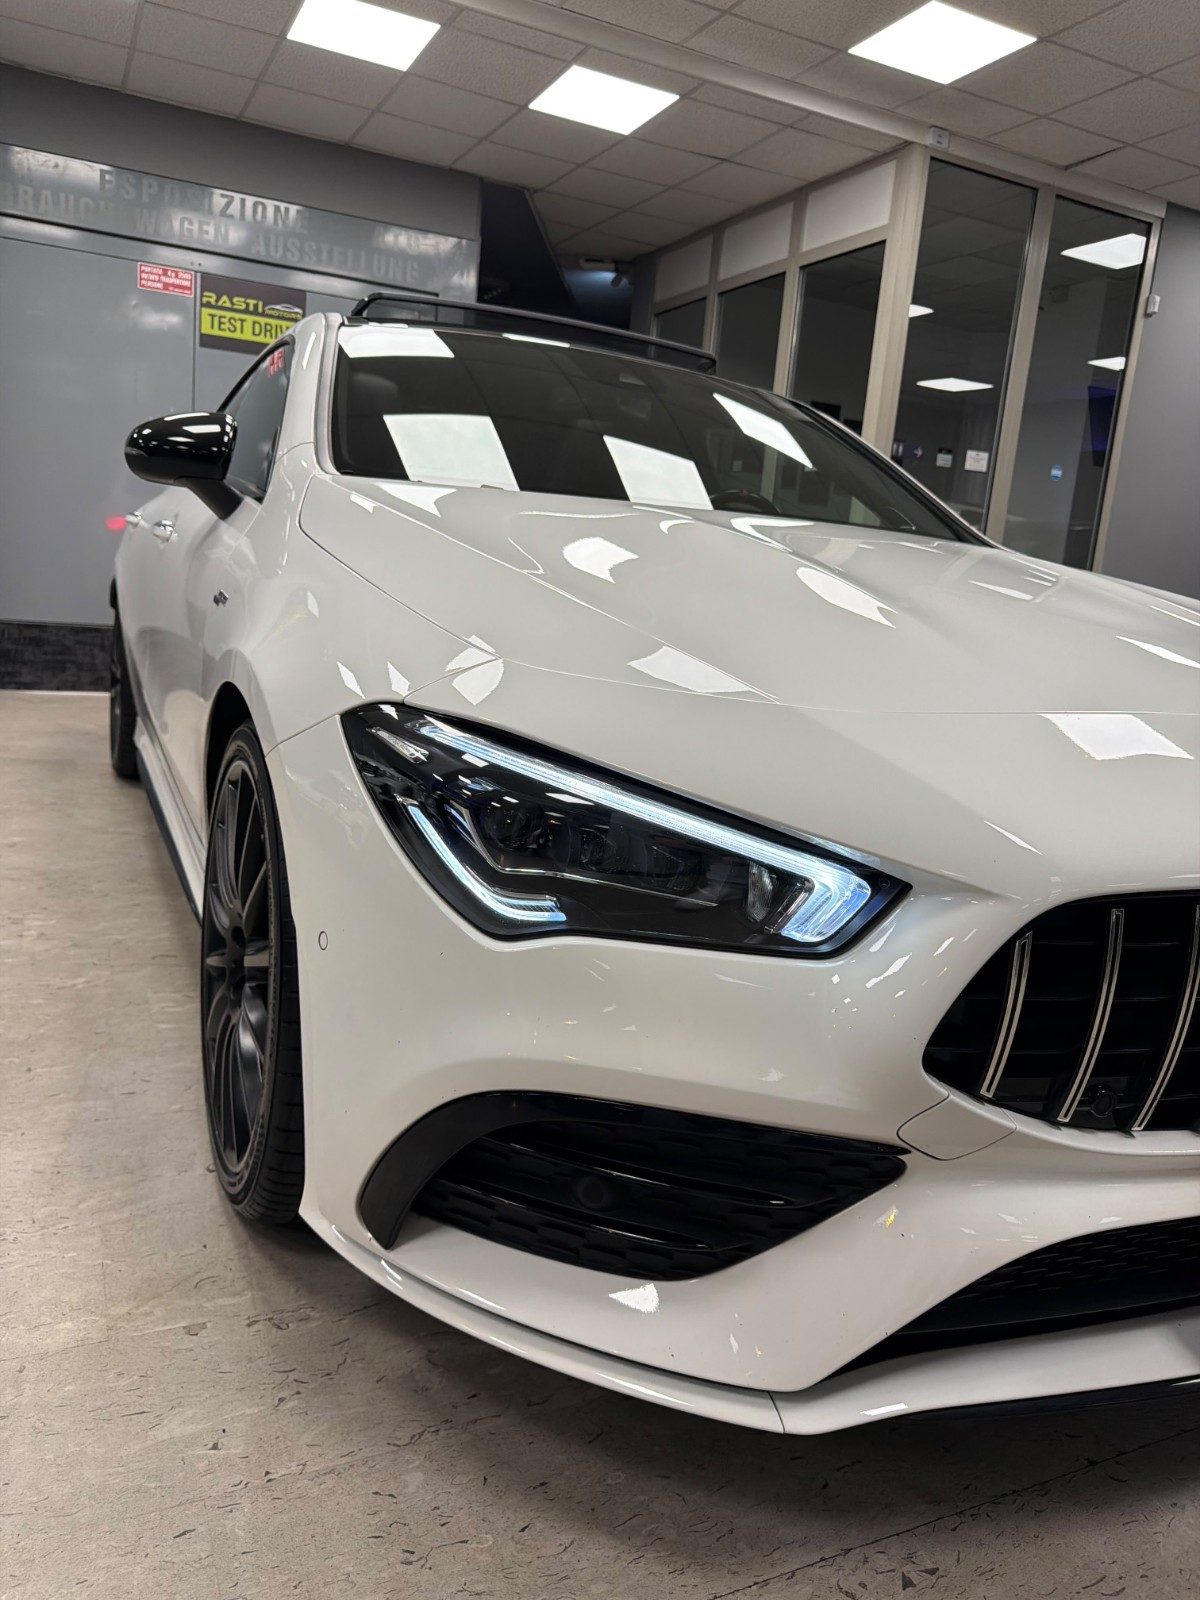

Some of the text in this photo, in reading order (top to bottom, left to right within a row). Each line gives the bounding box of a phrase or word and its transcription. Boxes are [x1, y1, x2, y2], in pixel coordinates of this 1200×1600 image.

[202, 291, 263, 313] RASTI
[208, 313, 290, 340] TEST DRIV
